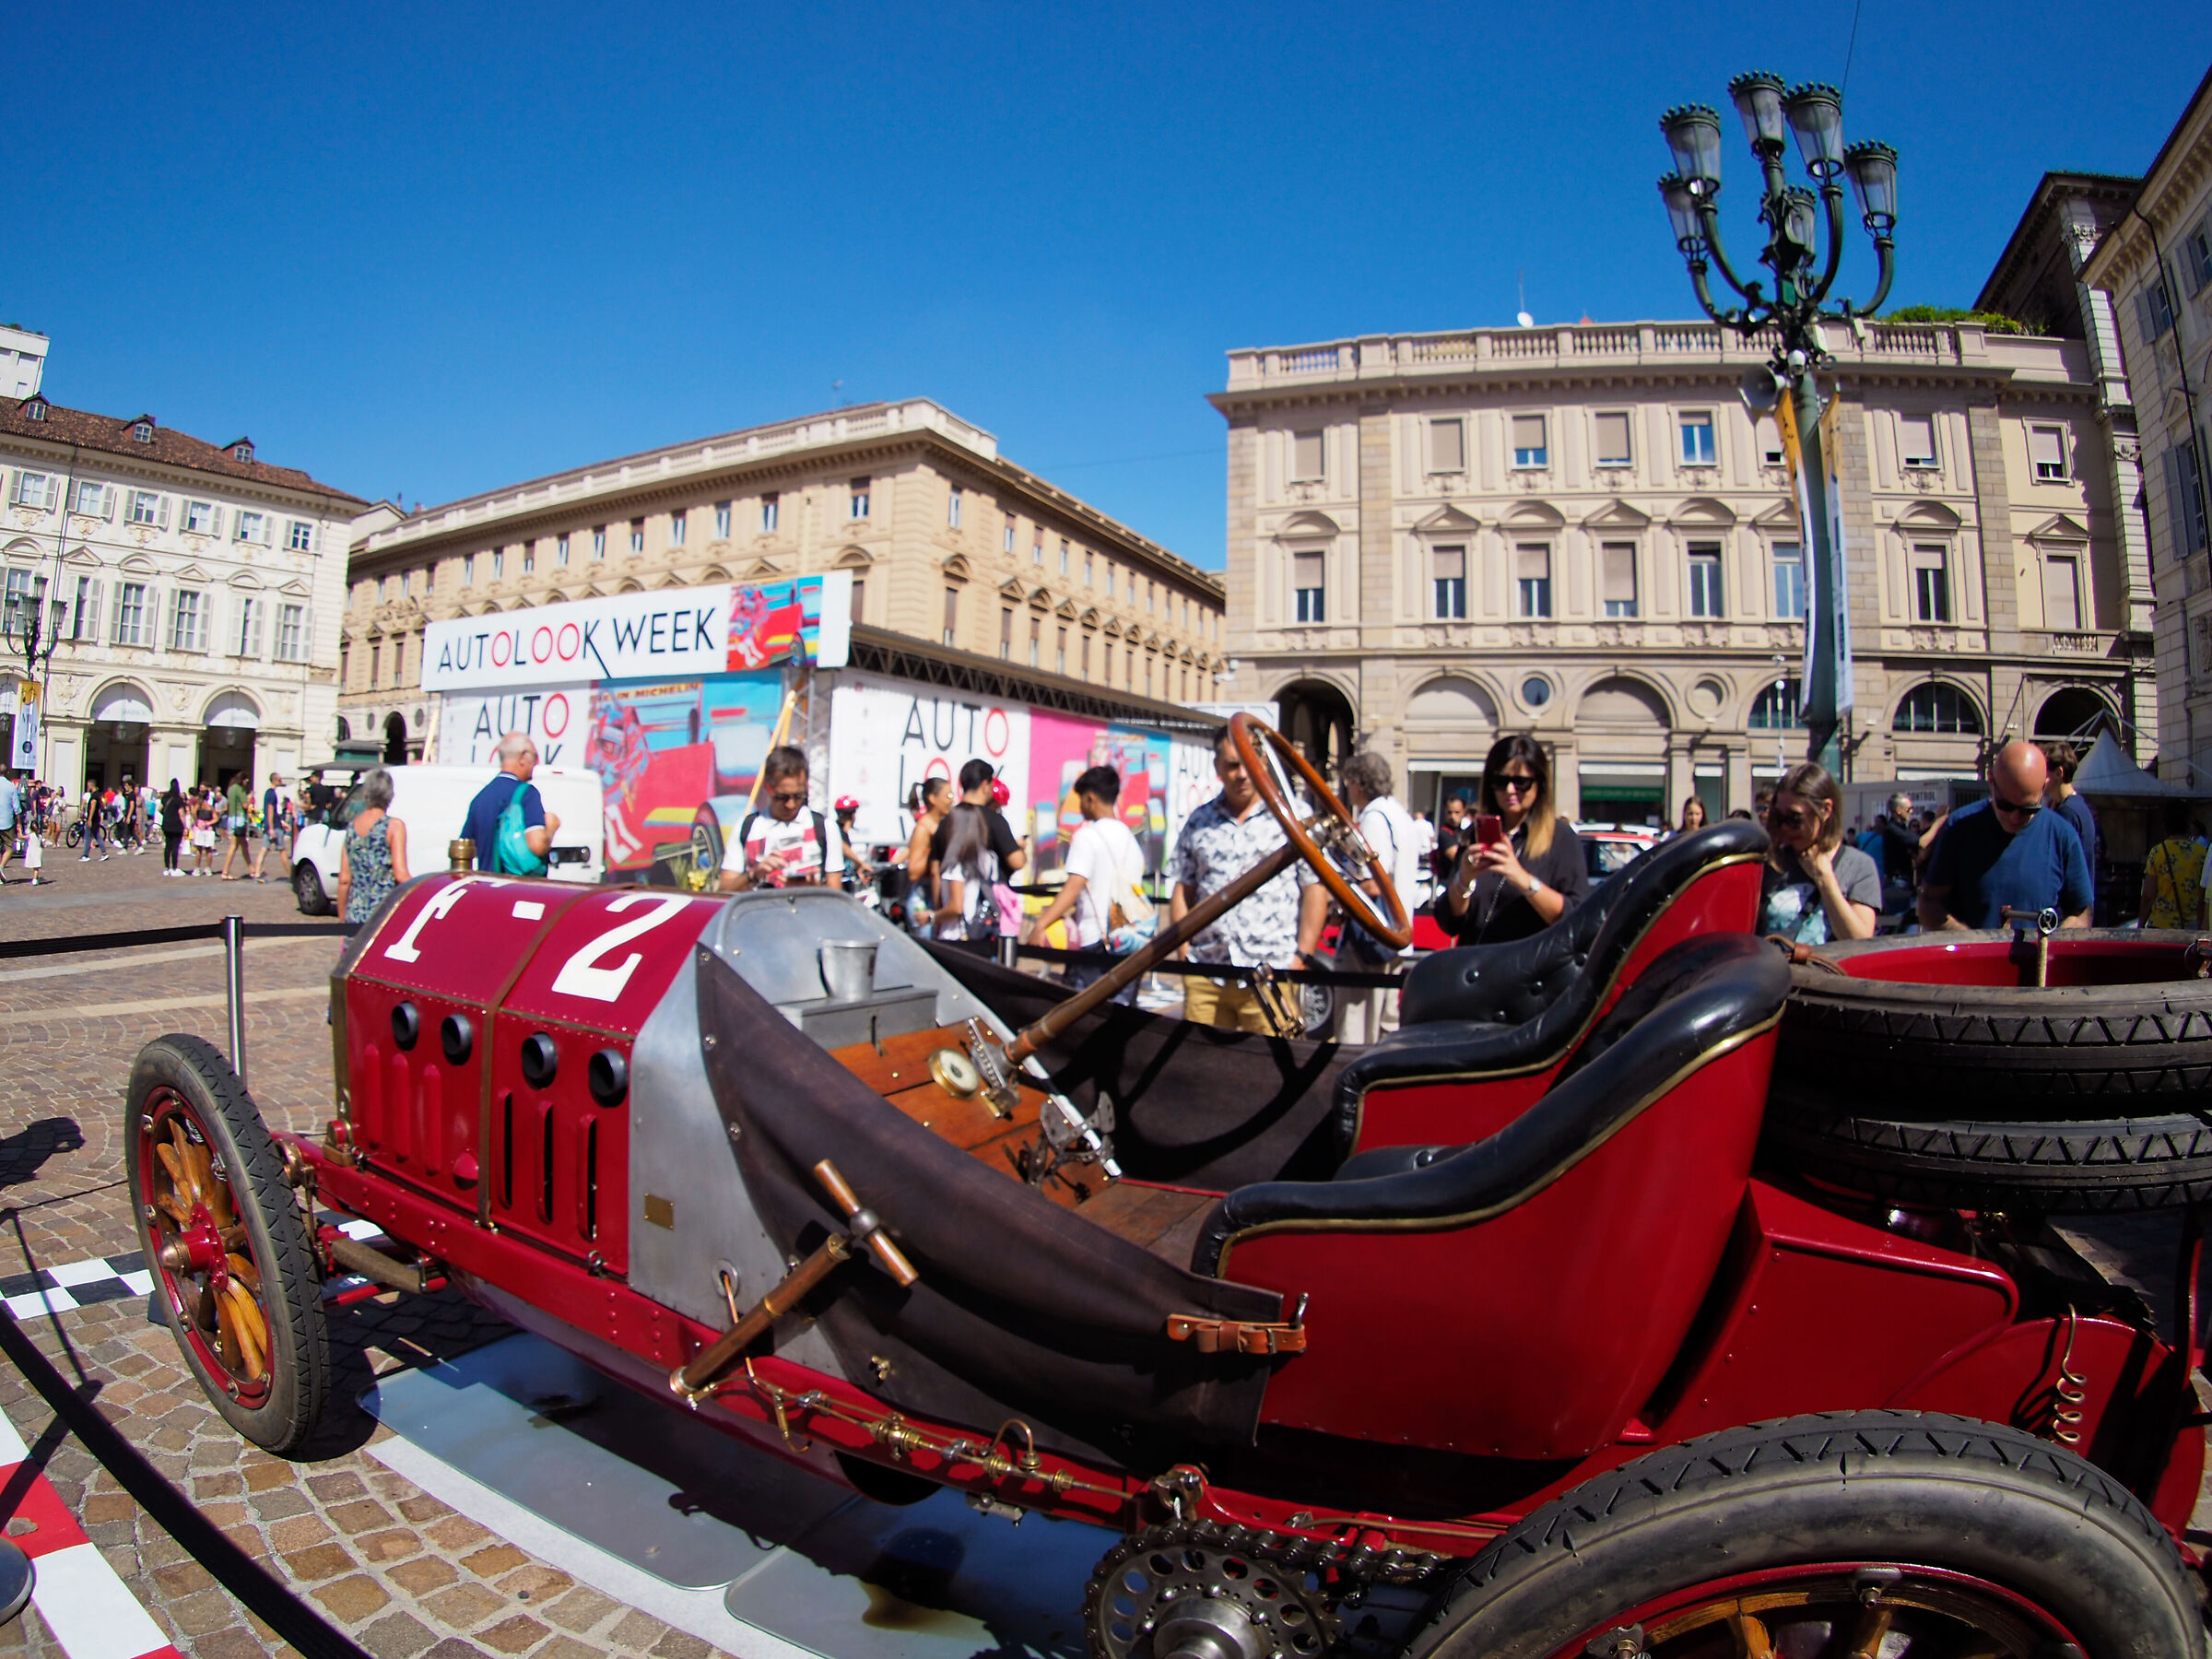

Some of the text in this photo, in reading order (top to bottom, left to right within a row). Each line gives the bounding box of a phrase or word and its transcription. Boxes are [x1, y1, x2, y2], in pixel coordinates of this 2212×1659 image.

[438, 618, 612, 678] AUTOLOOK
[613, 607, 716, 655] WEEK
[473, 693, 569, 740] AUTO
[901, 696, 1010, 758] AUTO
[1176, 743, 1218, 780] AUT
